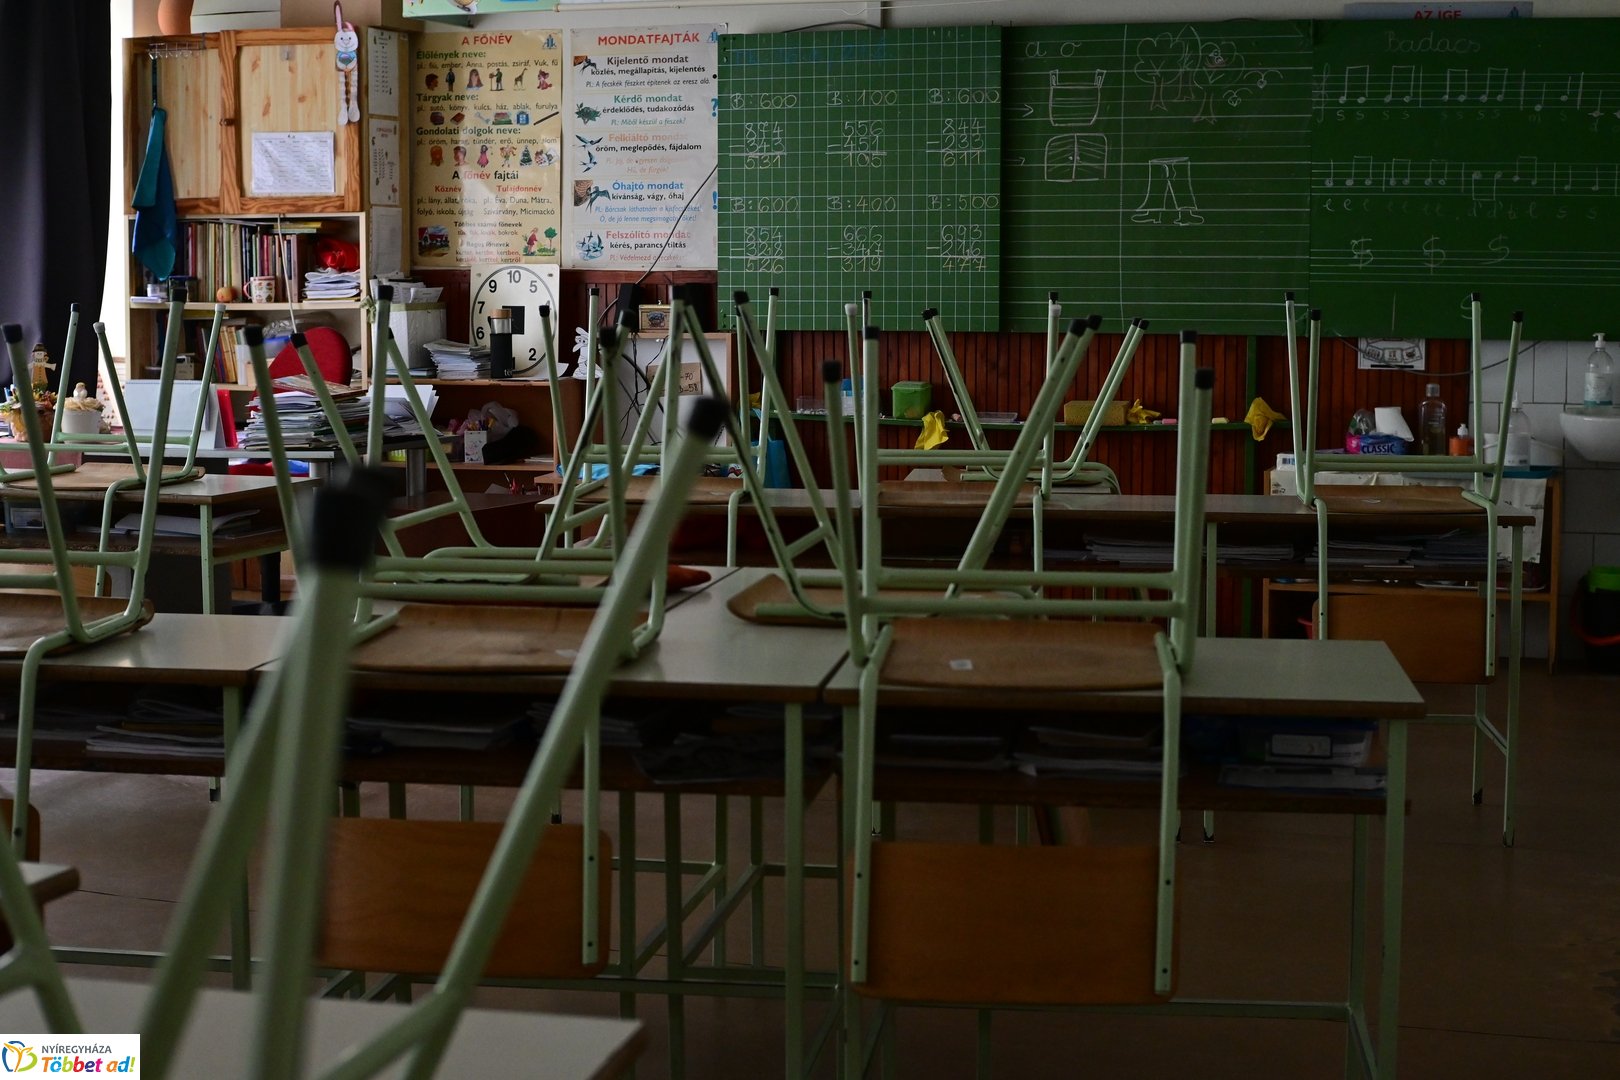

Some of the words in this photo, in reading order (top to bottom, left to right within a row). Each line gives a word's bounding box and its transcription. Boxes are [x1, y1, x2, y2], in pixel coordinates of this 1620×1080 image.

[462, 37, 469, 45] A
[474, 33, 513, 45] FŐNÉV
[598, 31, 699, 45] MONDATFAJTÁK
[416, 50, 459, 61] Élőlények
[441, 61, 463, 69] ember,
[607, 56, 648, 67] Kijelentő
[618, 67, 667, 76] megállapítás,
[602, 80, 622, 88] fecskék
[416, 94, 452, 103] Tárgyak
[614, 95, 642, 103] Kérdő
[646, 94, 682, 102] mondat
[416, 127, 459, 136] Gondolati
[463, 127, 493, 135] dolgok
[842, 120, 884, 136] 556
[942, 119, 985, 134] 844
[620, 143, 667, 153] meglepődés,
[669, 143, 701, 152] fájdalom
[744, 154, 782, 169] 531
[943, 152, 983, 166] 611
[452, 171, 459, 180] A
[463, 170, 491, 180] főnév
[494, 170, 518, 181] fajtái
[435, 185, 462, 193] Köznév
[496, 185, 542, 193] Tulajdonnév
[612, 180, 644, 191] Óhajtó
[428, 197, 442, 205] lány,
[612, 193, 645, 201] kívánság,
[647, 193, 665, 201] vágy,
[668, 192, 684, 200] óhaj
[665, 205, 702, 213] kisfecséket!
[606, 231, 651, 239] Felszólító
[744, 227, 783, 242] 854
[941, 225, 982, 241] 693
[745, 258, 784, 273] 526
[841, 258, 881, 271] 319
[942, 257, 986, 272] 477
[507, 270, 521, 283] 10
[489, 279, 497, 293] 9
[529, 280, 537, 293] 5
[478, 301, 485, 314] 7
[476, 327, 484, 339] 6
[529, 348, 536, 360] 2
[1361, 444, 1394, 454] CLASSIC
